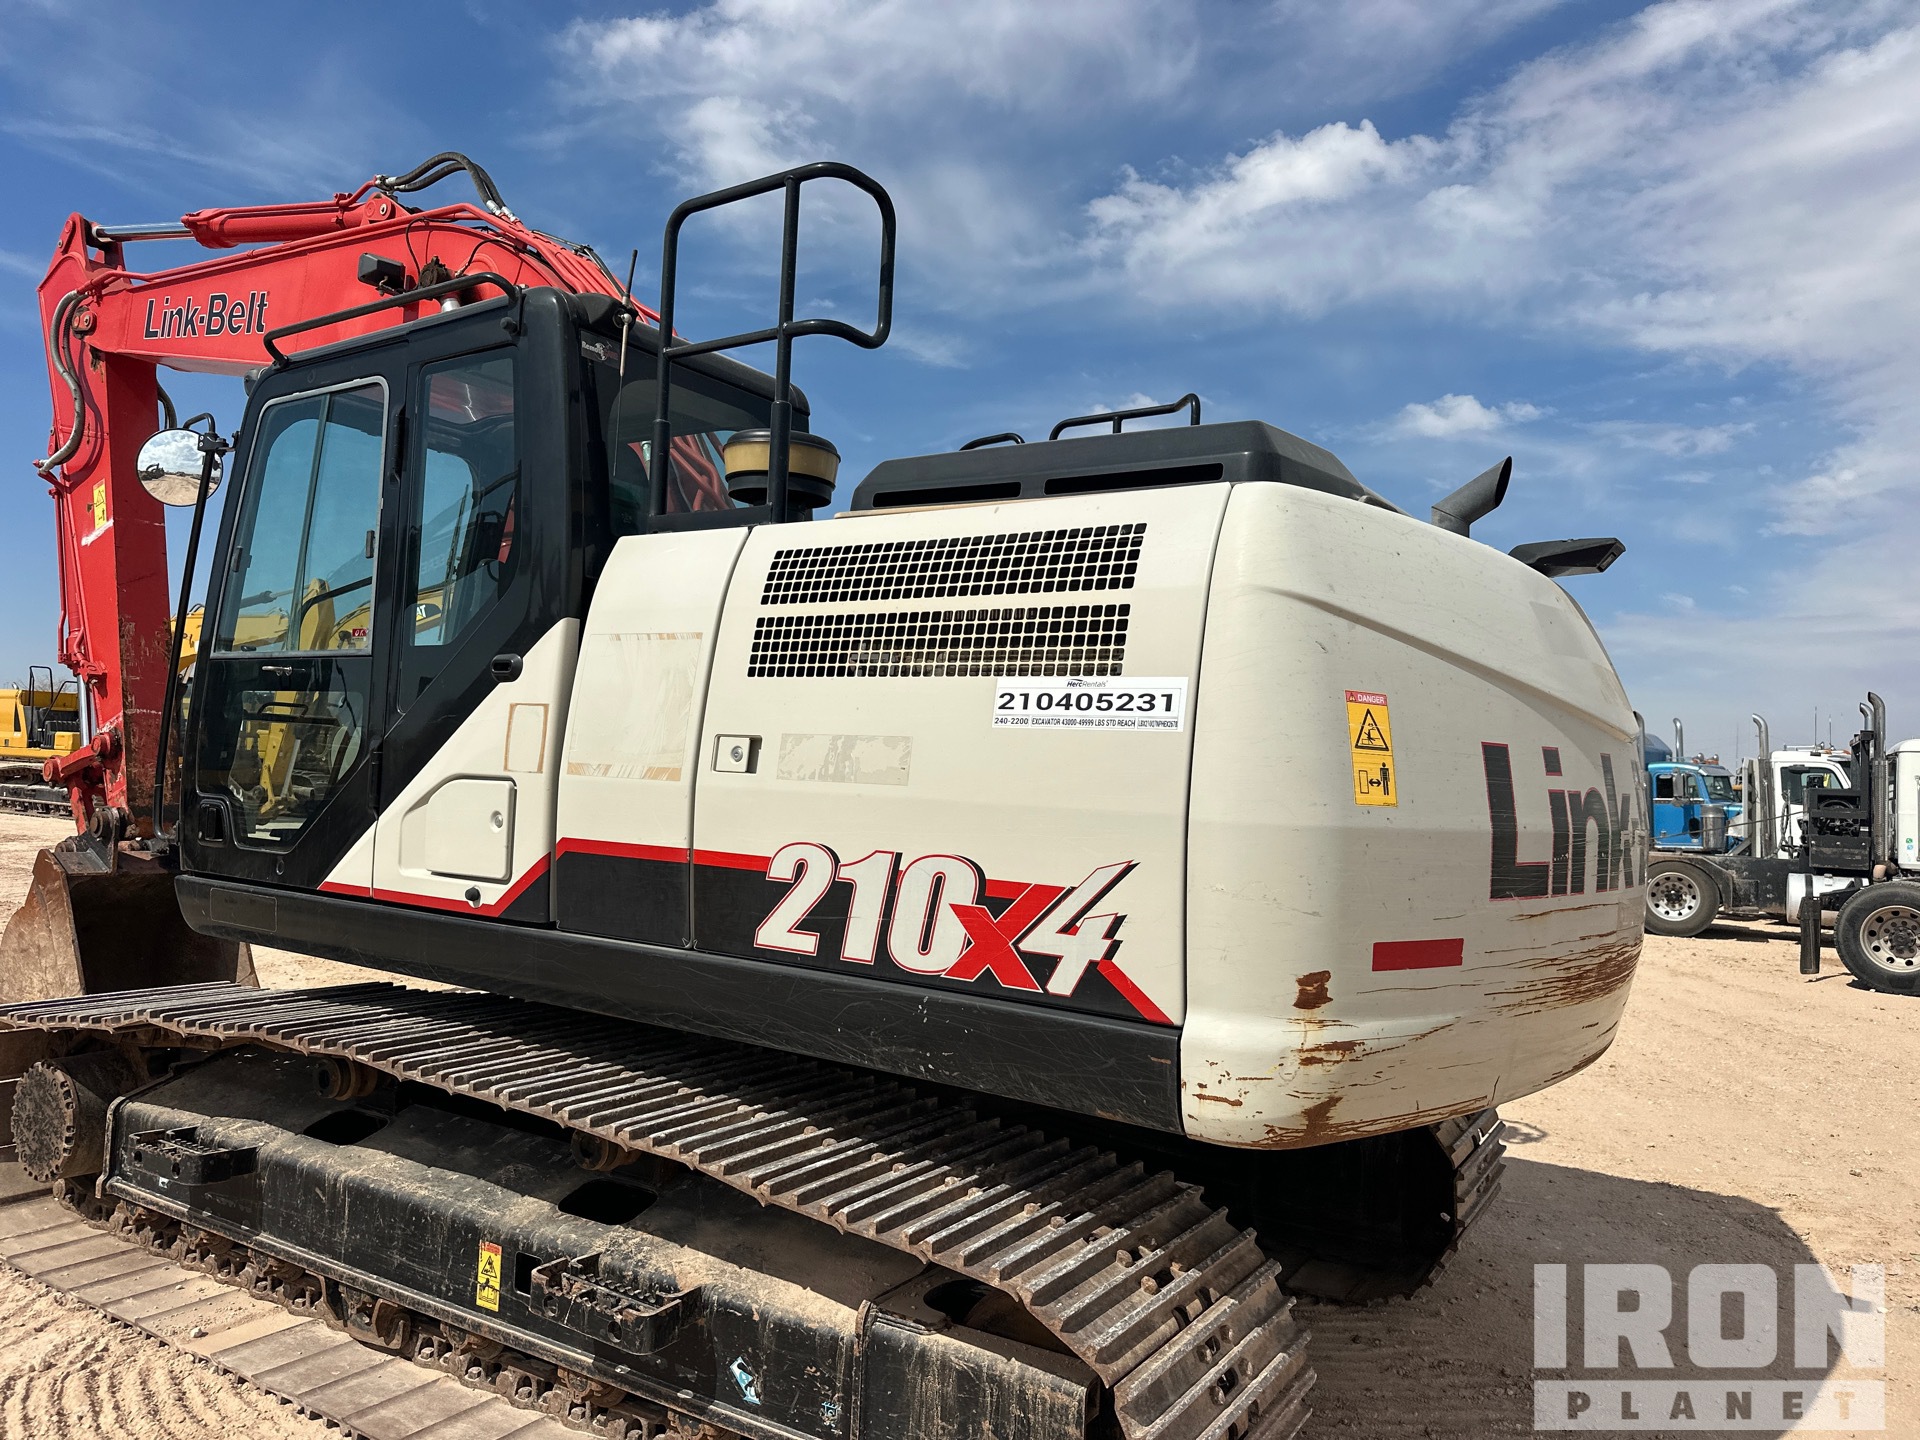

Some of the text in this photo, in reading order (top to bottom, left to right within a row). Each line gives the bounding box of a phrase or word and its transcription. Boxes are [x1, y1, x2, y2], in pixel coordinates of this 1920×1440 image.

[143, 290, 268, 339] Link-Belt
[416, 604, 427, 618] AT
[998, 692, 1173, 712] 210405231
[1357, 694, 1385, 704] DANGER
[994, 717, 1029, 725] 240-2200
[1031, 717, 1061, 726] EXCAVATOR
[1094, 719, 1105, 727] LBS
[1105, 719, 1116, 727] STD
[1117, 719, 1136, 728] REACH
